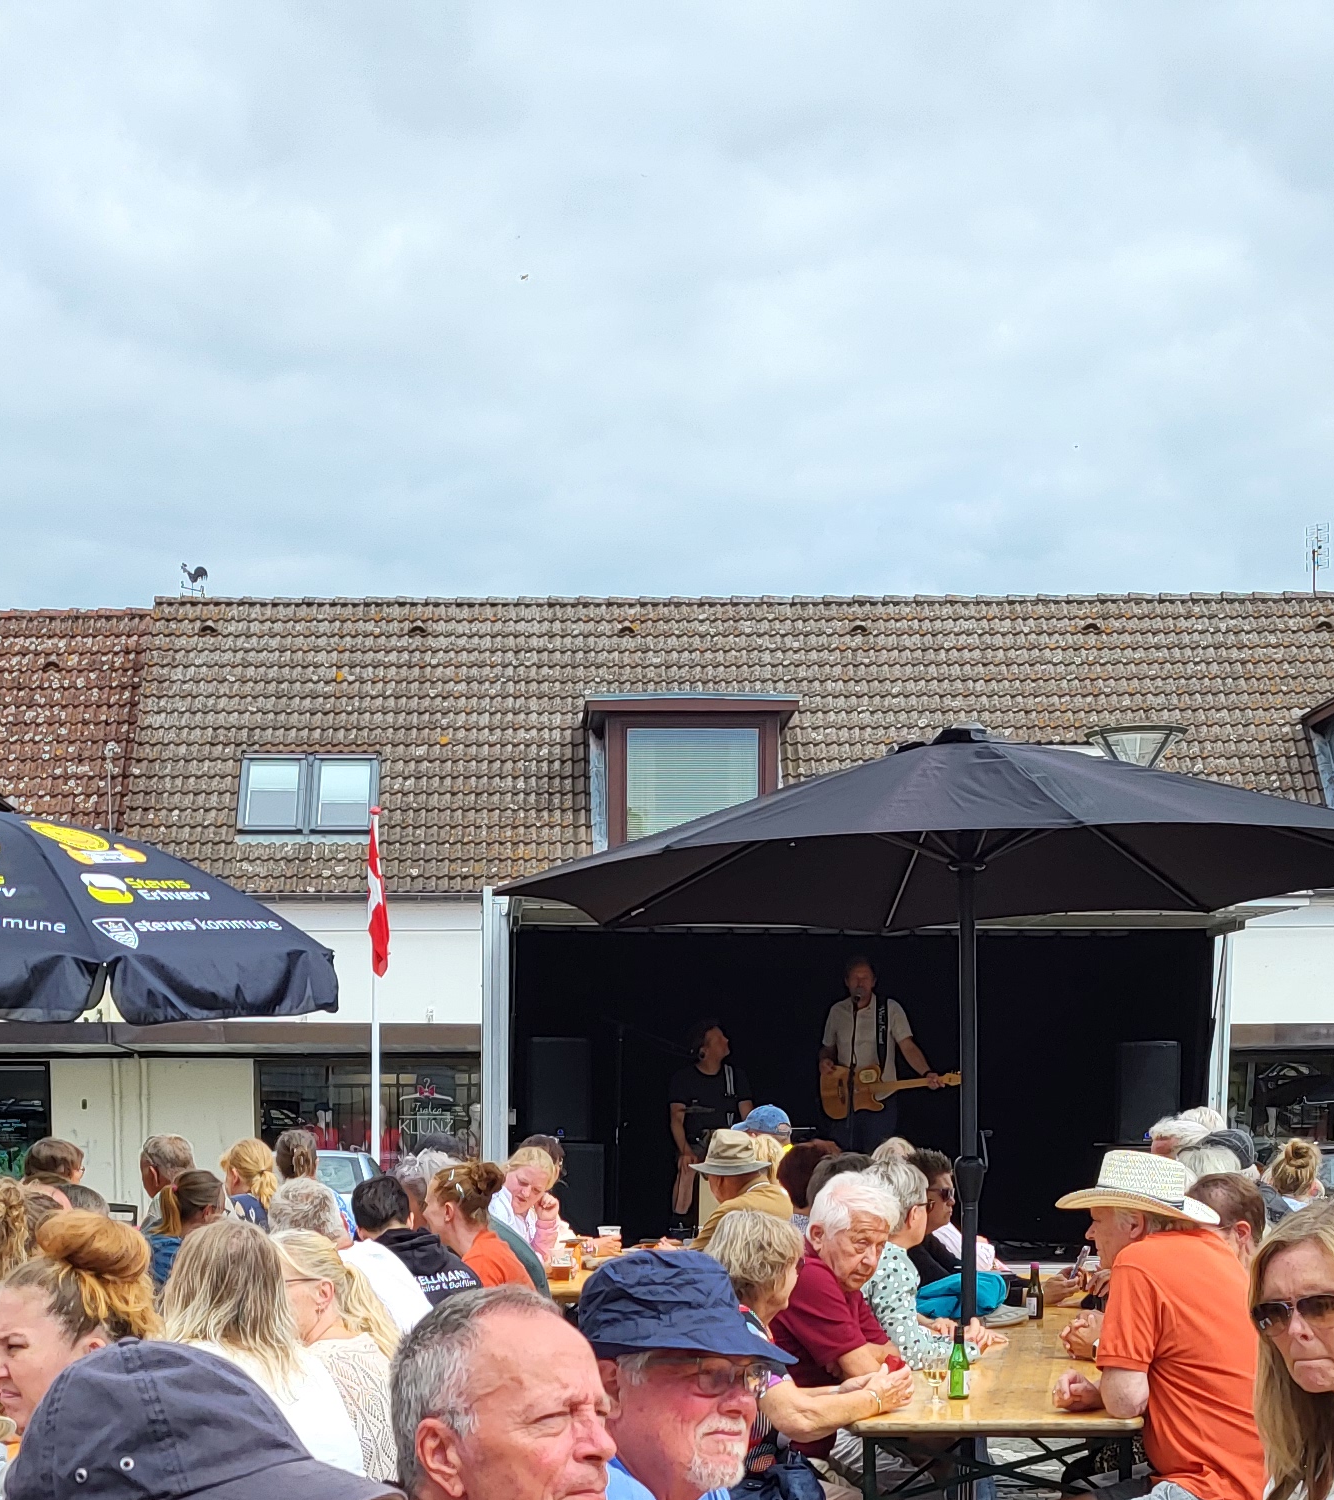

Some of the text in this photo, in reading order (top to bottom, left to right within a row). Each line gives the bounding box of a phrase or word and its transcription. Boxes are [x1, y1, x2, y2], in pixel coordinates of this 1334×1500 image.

[125, 877, 191, 890] Stevns
[137, 889, 211, 901] Erhverv
[134, 918, 283, 932] stevns kommune
[399, 1119, 454, 1135] KLUNZ
